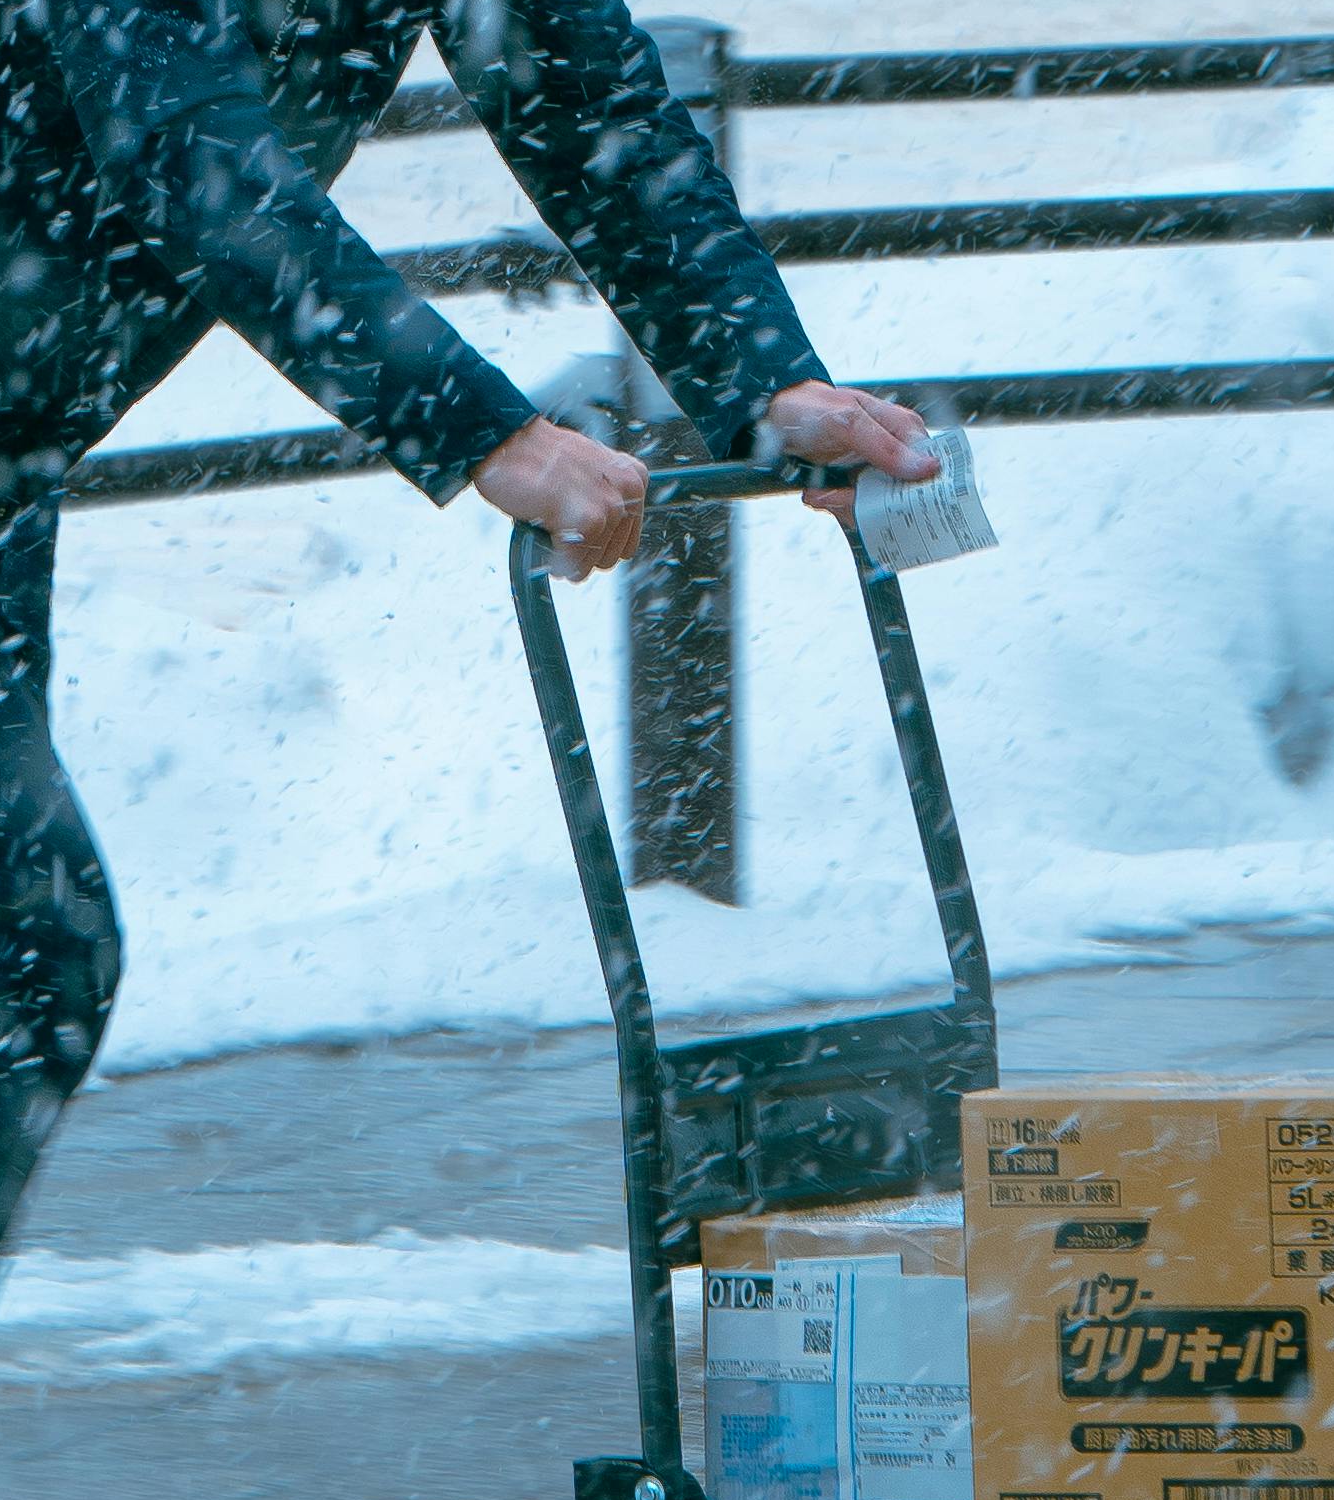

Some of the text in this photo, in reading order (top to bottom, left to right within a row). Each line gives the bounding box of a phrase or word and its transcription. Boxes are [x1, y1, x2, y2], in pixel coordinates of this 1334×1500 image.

[708, 1277, 757, 1309] 010
[1068, 1271, 1156, 1321] パワー
[1068, 1319, 1300, 1384] クリンキーパー
